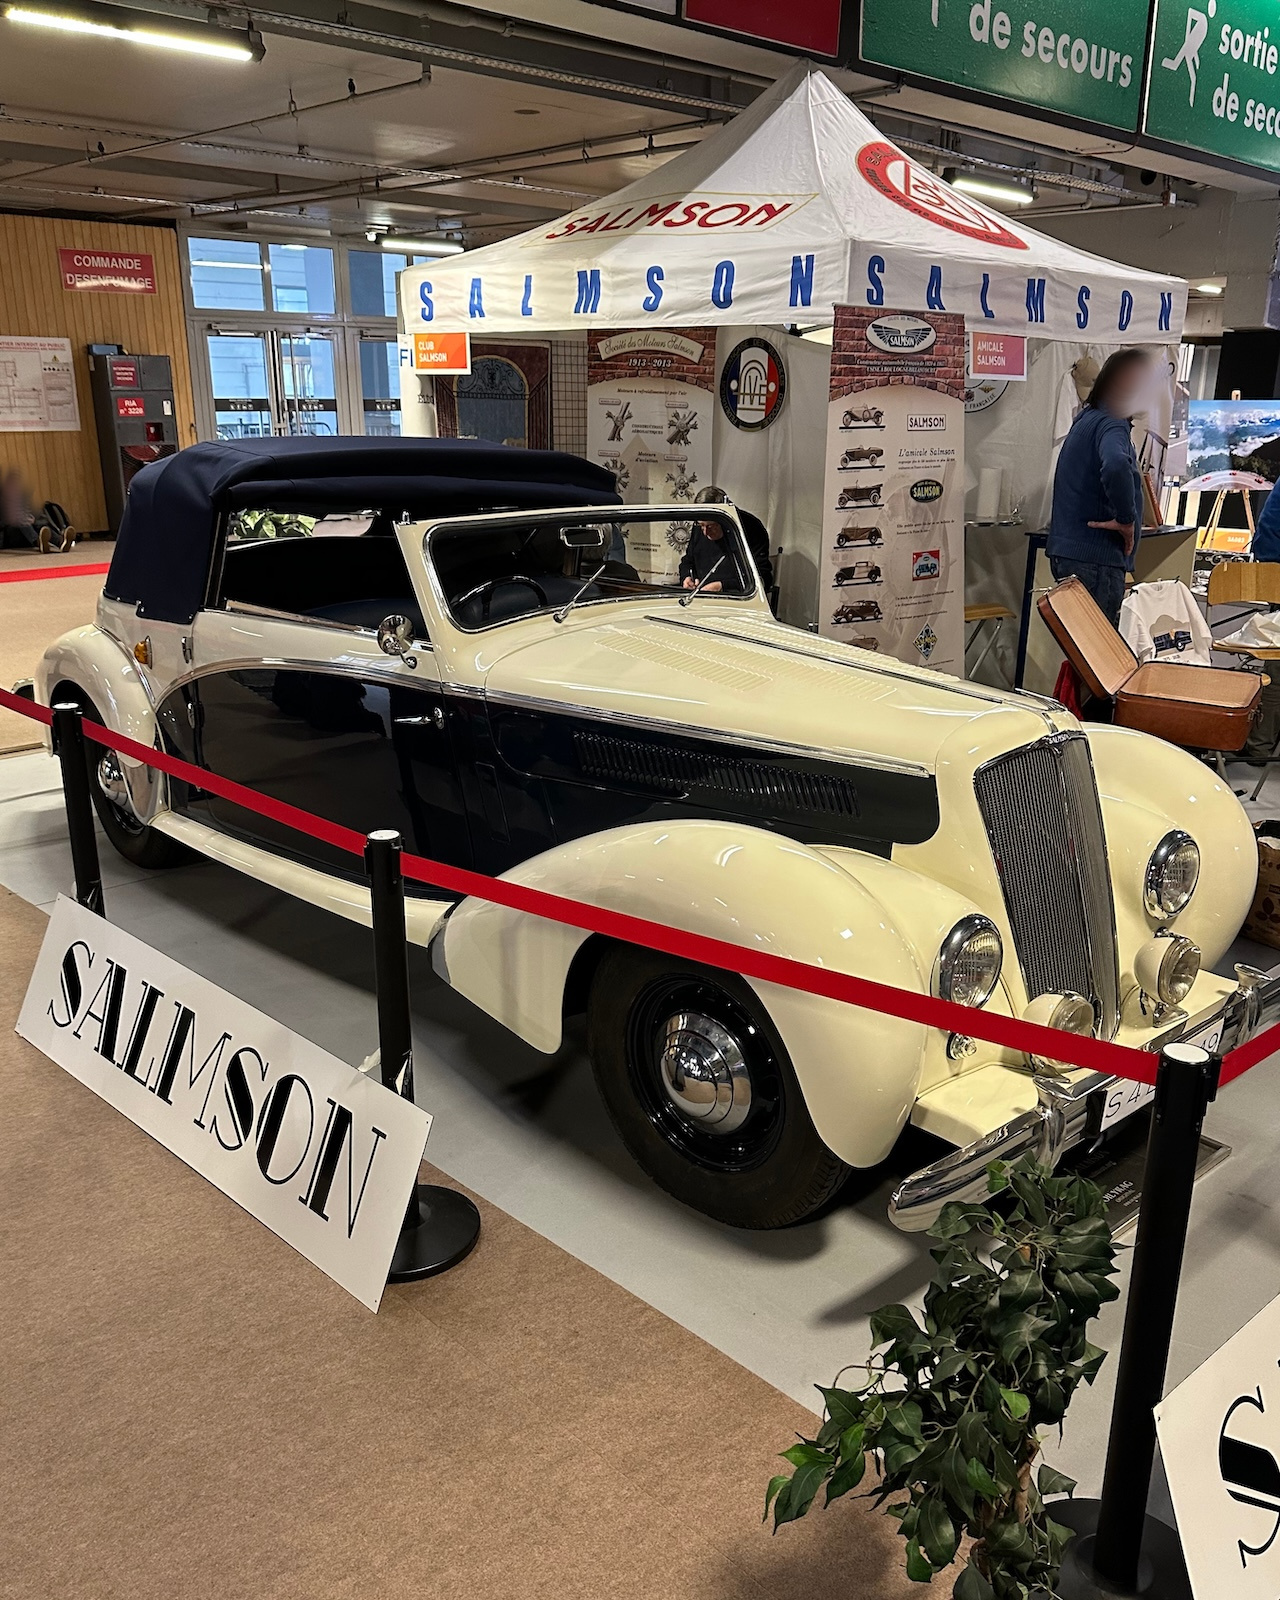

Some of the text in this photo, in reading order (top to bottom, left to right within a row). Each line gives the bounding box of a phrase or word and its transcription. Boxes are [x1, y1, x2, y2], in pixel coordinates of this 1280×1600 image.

[968, 0, 1133, 88] de secours
[1218, 23, 1279, 76] sortie
[1211, 72, 1240, 123] de
[545, 200, 794, 240] SALMSON
[73, 254, 142, 271] COMMANDE
[66, 273, 153, 289] DESENFUMAGE
[418, 254, 816, 322] SALMSON
[866, 255, 1172, 332] SALMSON
[418, 341, 435, 350] CLUB
[889, 335, 915, 347] SALMSON
[977, 340, 1004, 353] AMICALE
[419, 352, 448, 362] SALMSON
[628, 358, 647, 367] 1913
[652, 359, 672, 368] 2013
[977, 354, 1006, 367] SALMSON
[124, 399, 137, 407] RIA
[909, 417, 944, 428] SALMSON
[898, 447, 955, 458] L'amicale Salmson
[913, 485, 941, 498] SALMSON
[46, 940, 388, 1240] SALMSON
[1218, 1357, 1280, 1570] S
